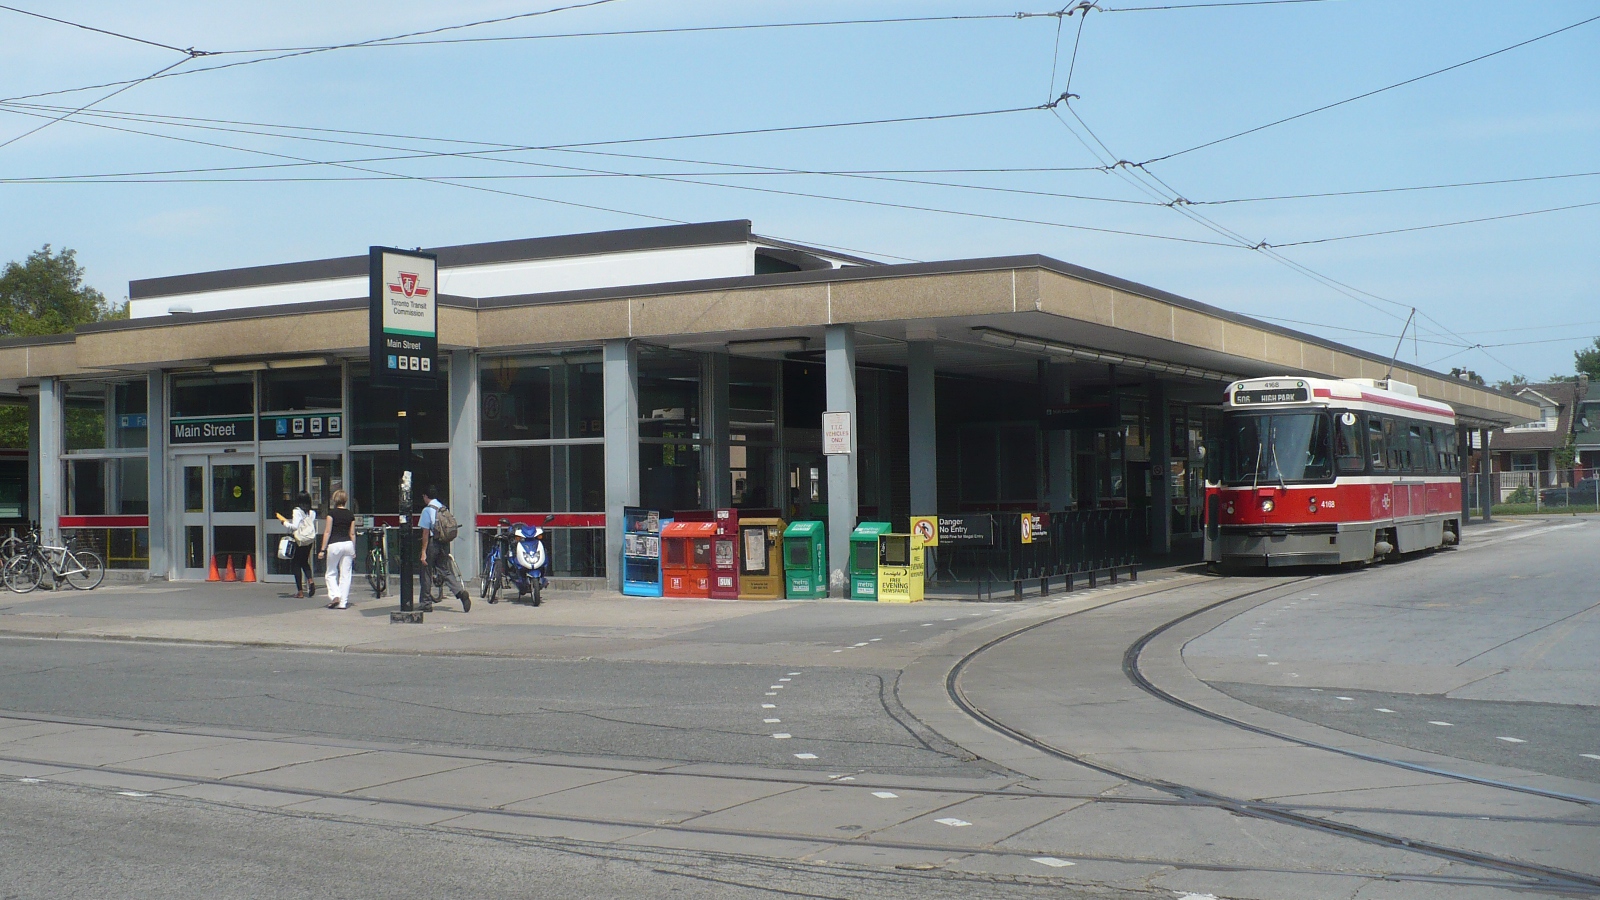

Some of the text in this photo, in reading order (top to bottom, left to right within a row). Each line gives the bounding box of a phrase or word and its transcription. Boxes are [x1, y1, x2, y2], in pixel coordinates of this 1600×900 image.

[390, 298, 427, 309] Toronto Transit
[393, 307, 425, 317] Commission
[386, 338, 421, 350] Main Street
[1237, 393, 1295, 403] 506 HIGH PARK
[175, 423, 236, 438] Main Street
[1321, 500, 1336, 508] 4168
[939, 518, 963, 527] Danger
[950, 526, 968, 534] Entry
